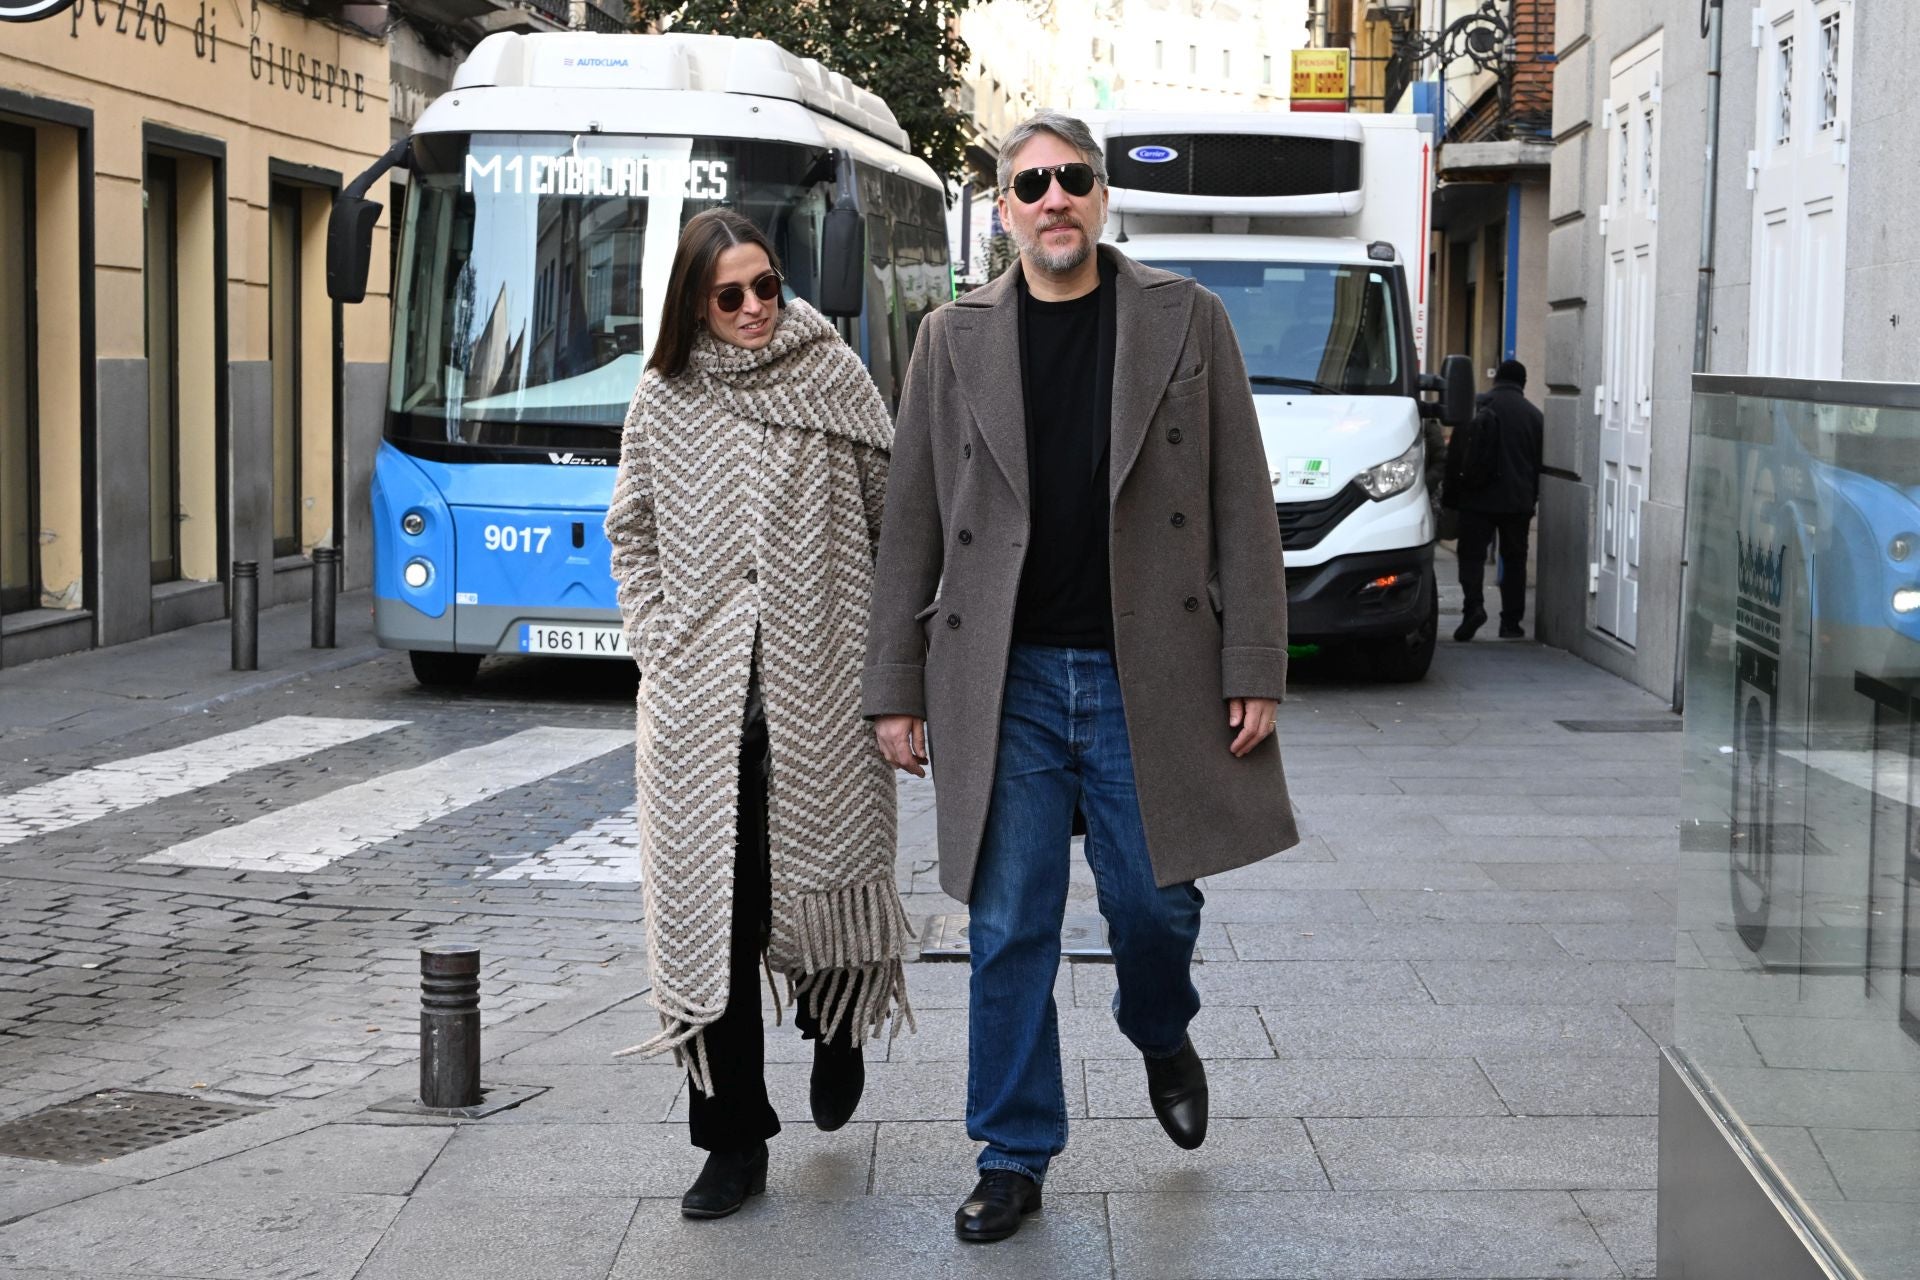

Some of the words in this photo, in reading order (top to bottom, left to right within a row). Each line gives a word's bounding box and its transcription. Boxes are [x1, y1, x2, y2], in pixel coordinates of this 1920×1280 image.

[194, 0, 218, 63] di
[250, 36, 365, 113] GIUSEPPE
[1139, 150, 1167, 158] Carrier
[465, 154, 523, 193] M1
[484, 524, 552, 553] 9017
[537, 629, 584, 650] 1661
[595, 632, 631, 652] KV
